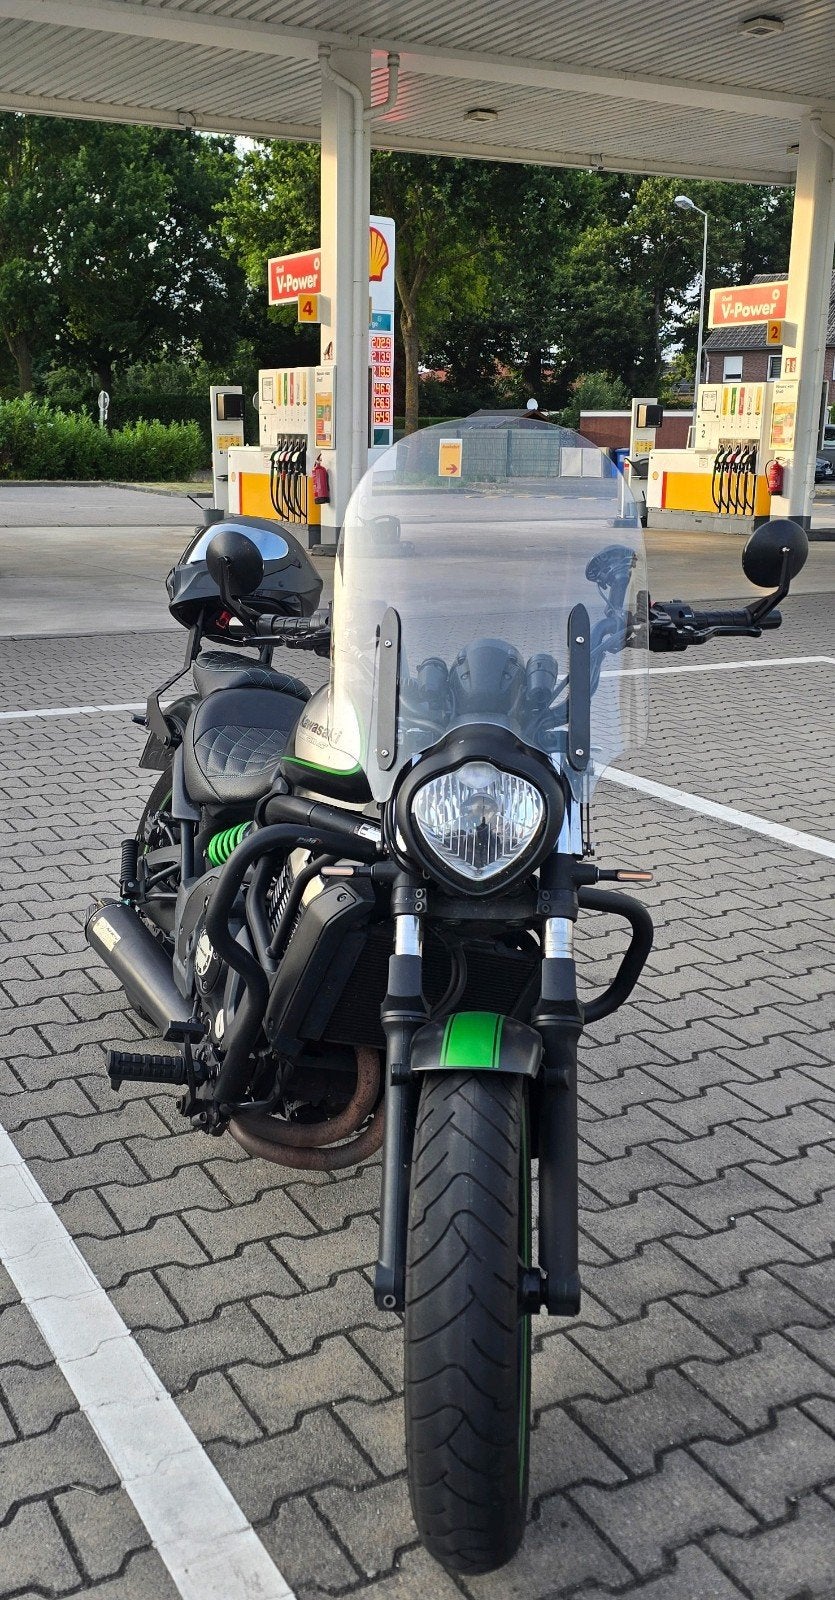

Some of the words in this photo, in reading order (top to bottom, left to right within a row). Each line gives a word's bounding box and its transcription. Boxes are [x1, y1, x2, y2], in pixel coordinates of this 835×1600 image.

[276, 274, 318, 294] V-Power
[302, 301, 314, 316] 4
[722, 302, 776, 319] V-Power
[770, 326, 778, 339] 2
[300, 714, 342, 744] Kawasaki
